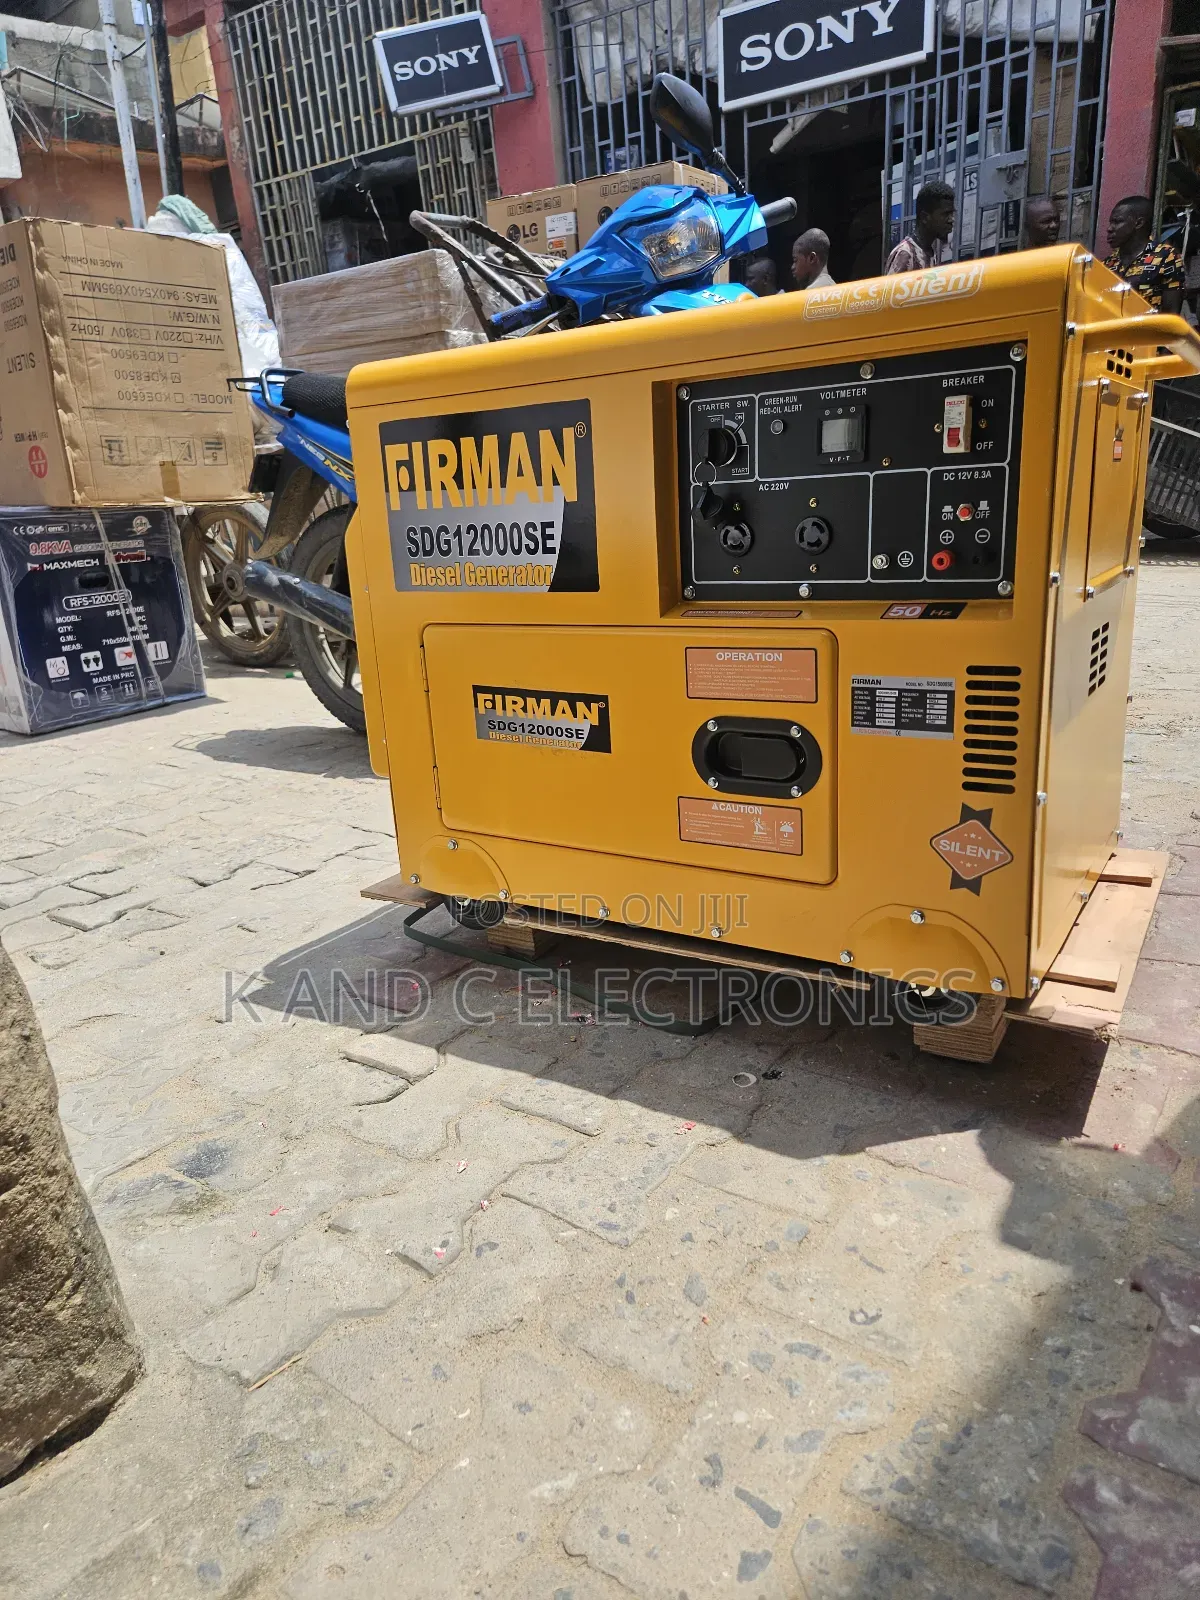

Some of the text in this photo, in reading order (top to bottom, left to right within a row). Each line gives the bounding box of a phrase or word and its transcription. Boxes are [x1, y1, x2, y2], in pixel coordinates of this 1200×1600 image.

[740, 0, 899, 72] SONY
[394, 44, 481, 80] SONY
[522, 222, 538, 238] LG
[61, 254, 124, 269] MADE IN CHINA
[810, 288, 843, 304] AVR
[896, 264, 980, 300] Silent
[182, 290, 218, 304] MEAS:
[811, 306, 838, 316] system
[194, 332, 224, 344] V/Hz:
[8, 352, 36, 374] SILENT
[942, 375, 985, 388] BREAKER
[820, 388, 867, 400] VOLTMETER
[698, 400, 750, 412] STARTER SW.
[784, 404, 802, 414] ALERT
[981, 399, 994, 408] ON
[976, 441, 994, 450] OFF
[384, 427, 578, 510] FIRMAN
[943, 470, 992, 480] DC 12V 8.3A
[771, 482, 790, 490] 220V
[406, 521, 557, 558] SDG12000SE
[29, 540, 74, 556] 9.8KVA
[43, 558, 100, 572] MAXMECH
[410, 561, 554, 586] Diesel Generator
[888, 605, 920, 617] 50
[56, 615, 82, 624] MODEL:
[62, 644, 83, 652] MEAS:
[716, 652, 782, 662] OPERATION
[92, 674, 113, 684] MADE
[121, 671, 135, 679] PRC
[477, 693, 599, 726] FIRMAN
[488, 720, 585, 740] SDG12000SE
[489, 731, 582, 749] Diesel Generator
[719, 803, 762, 815] CAUTION
[939, 839, 1004, 862] SILENT
